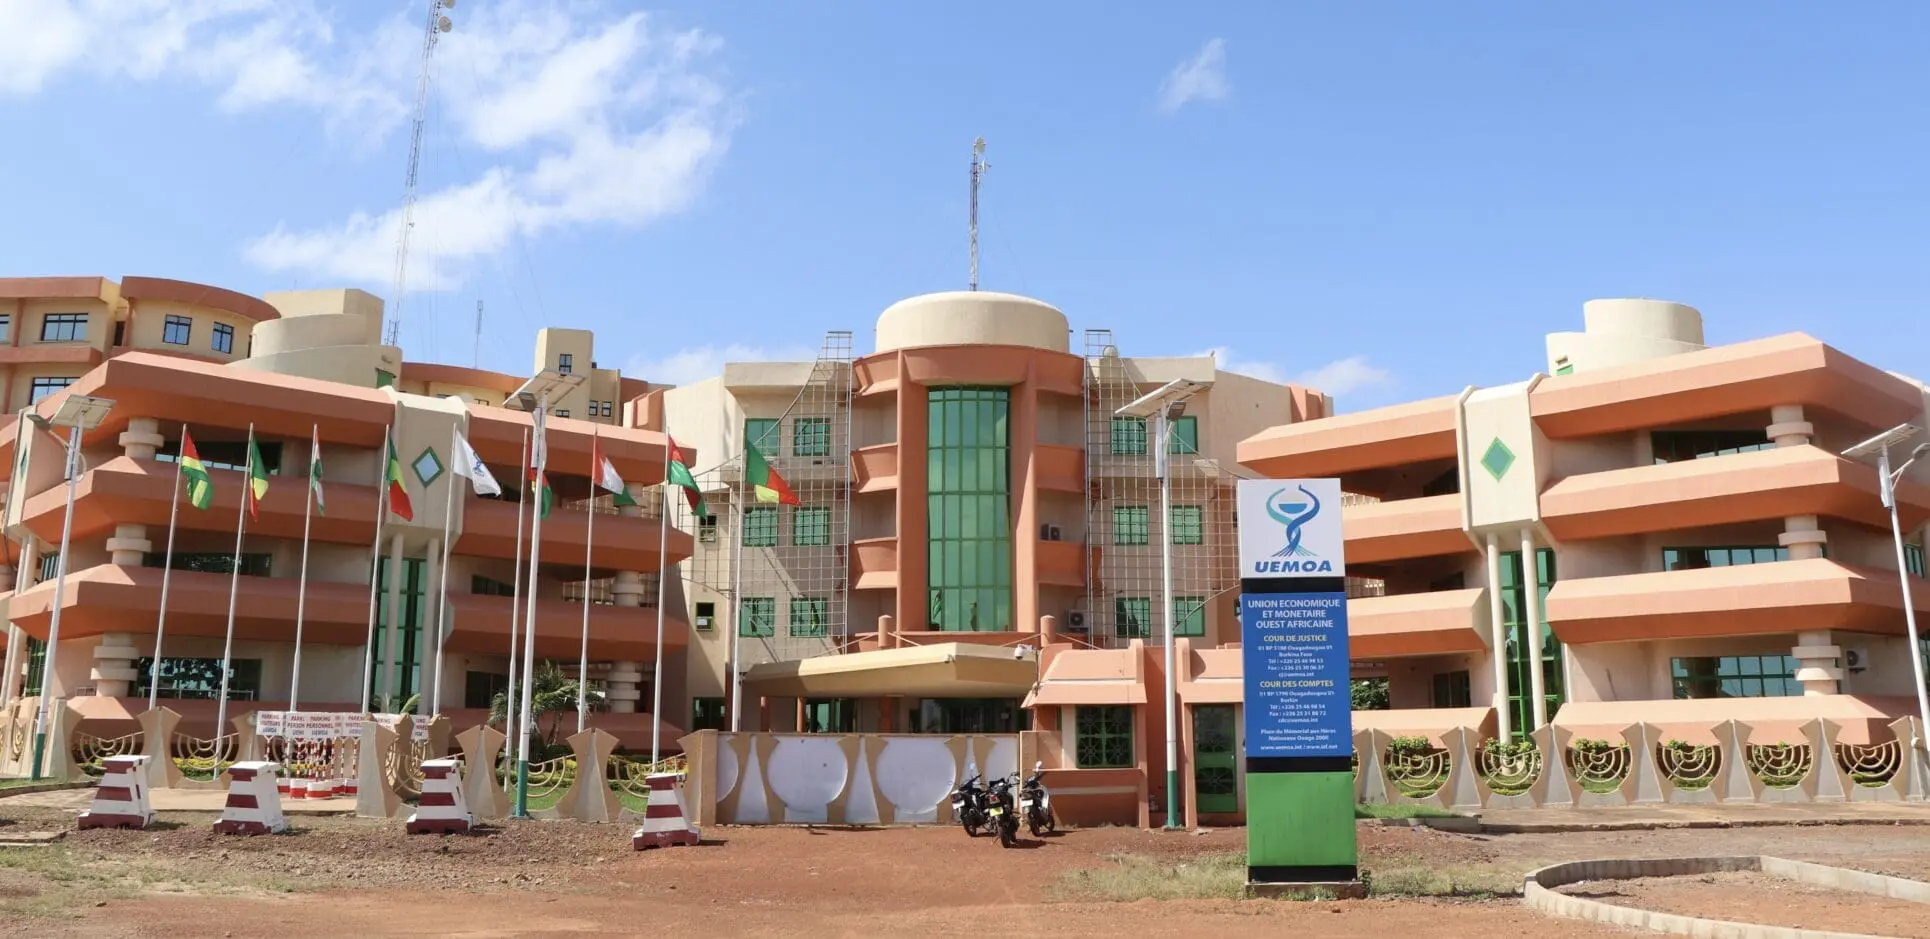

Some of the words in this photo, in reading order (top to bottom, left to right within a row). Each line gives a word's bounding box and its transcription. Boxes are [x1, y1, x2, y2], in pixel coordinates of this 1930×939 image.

[1255, 560, 1332, 572] UEMOA
[1280, 600, 1340, 608] ECONOMIQUE
[1256, 620, 1285, 628] OUEST
